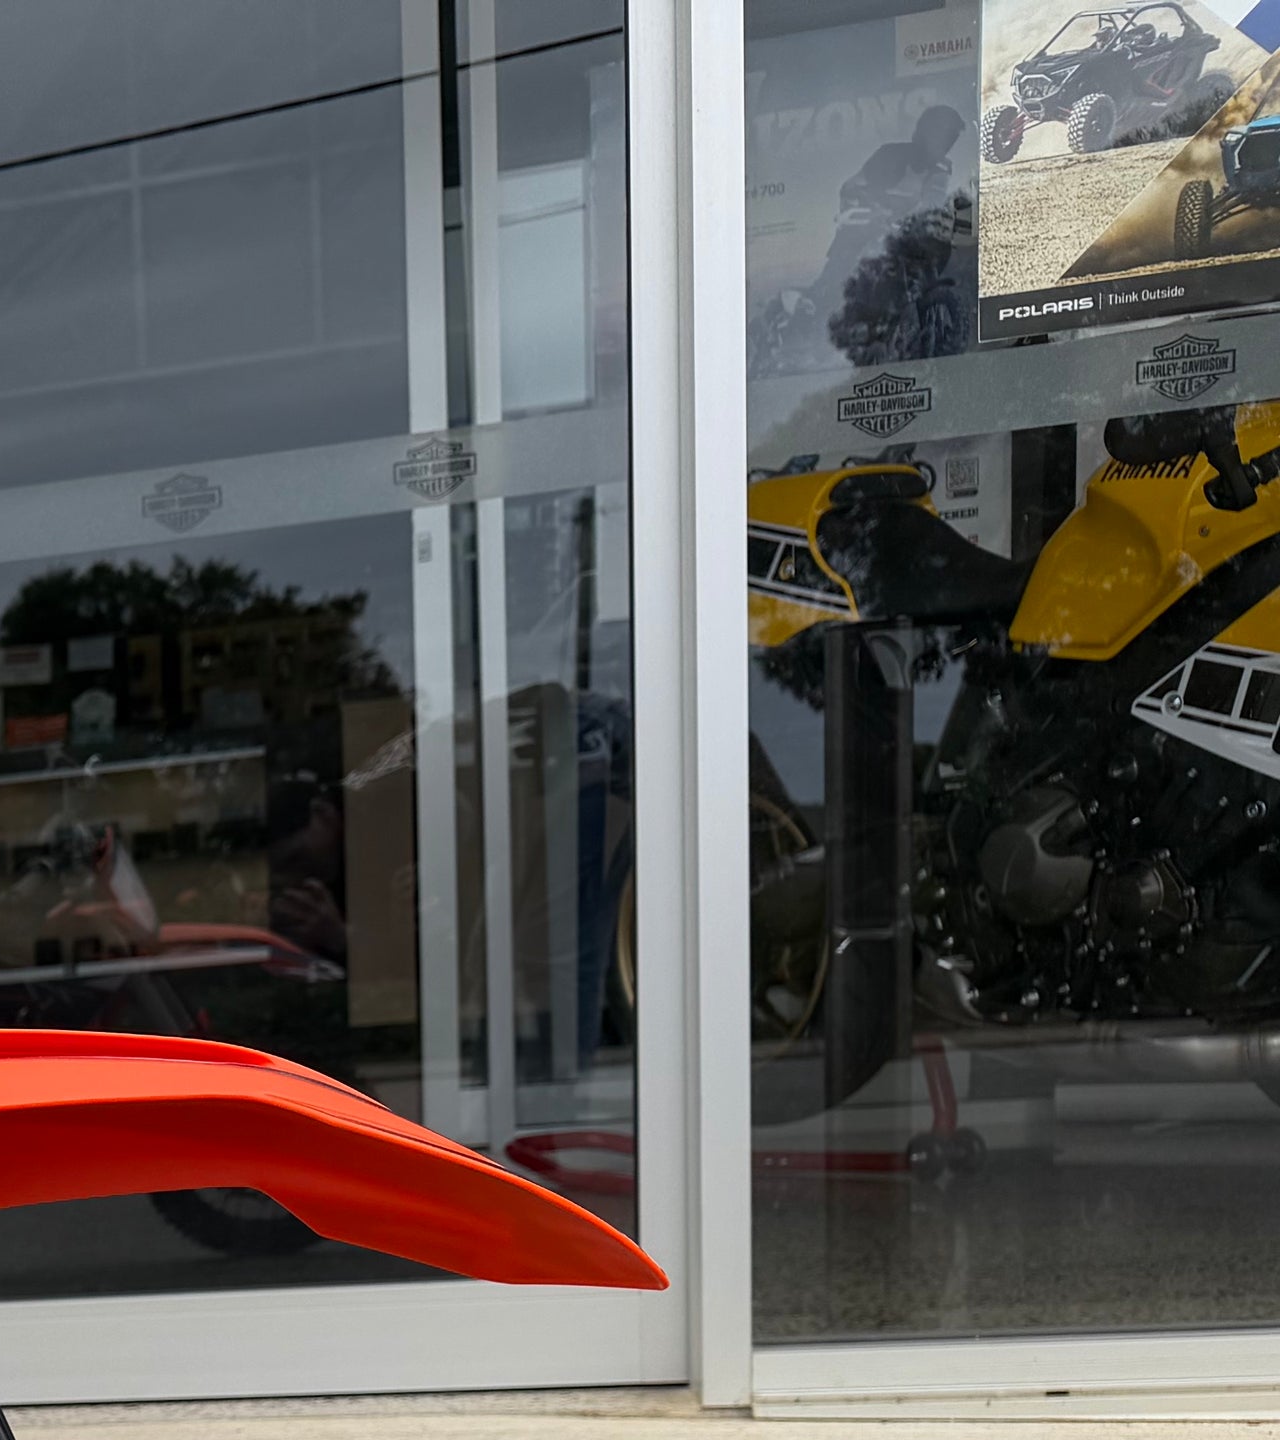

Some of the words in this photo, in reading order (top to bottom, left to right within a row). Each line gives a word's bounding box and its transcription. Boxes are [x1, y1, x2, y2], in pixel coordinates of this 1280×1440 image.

[920, 36, 972, 56] YAMAHA
[999, 297, 1094, 321] POLARIS
[1108, 292, 1139, 306] Think
[1141, 285, 1185, 302] Outside
[1142, 356, 1229, 379] HARLEY-DAVIDSON
[844, 394, 925, 416] HARLEY-DAVIDSON
